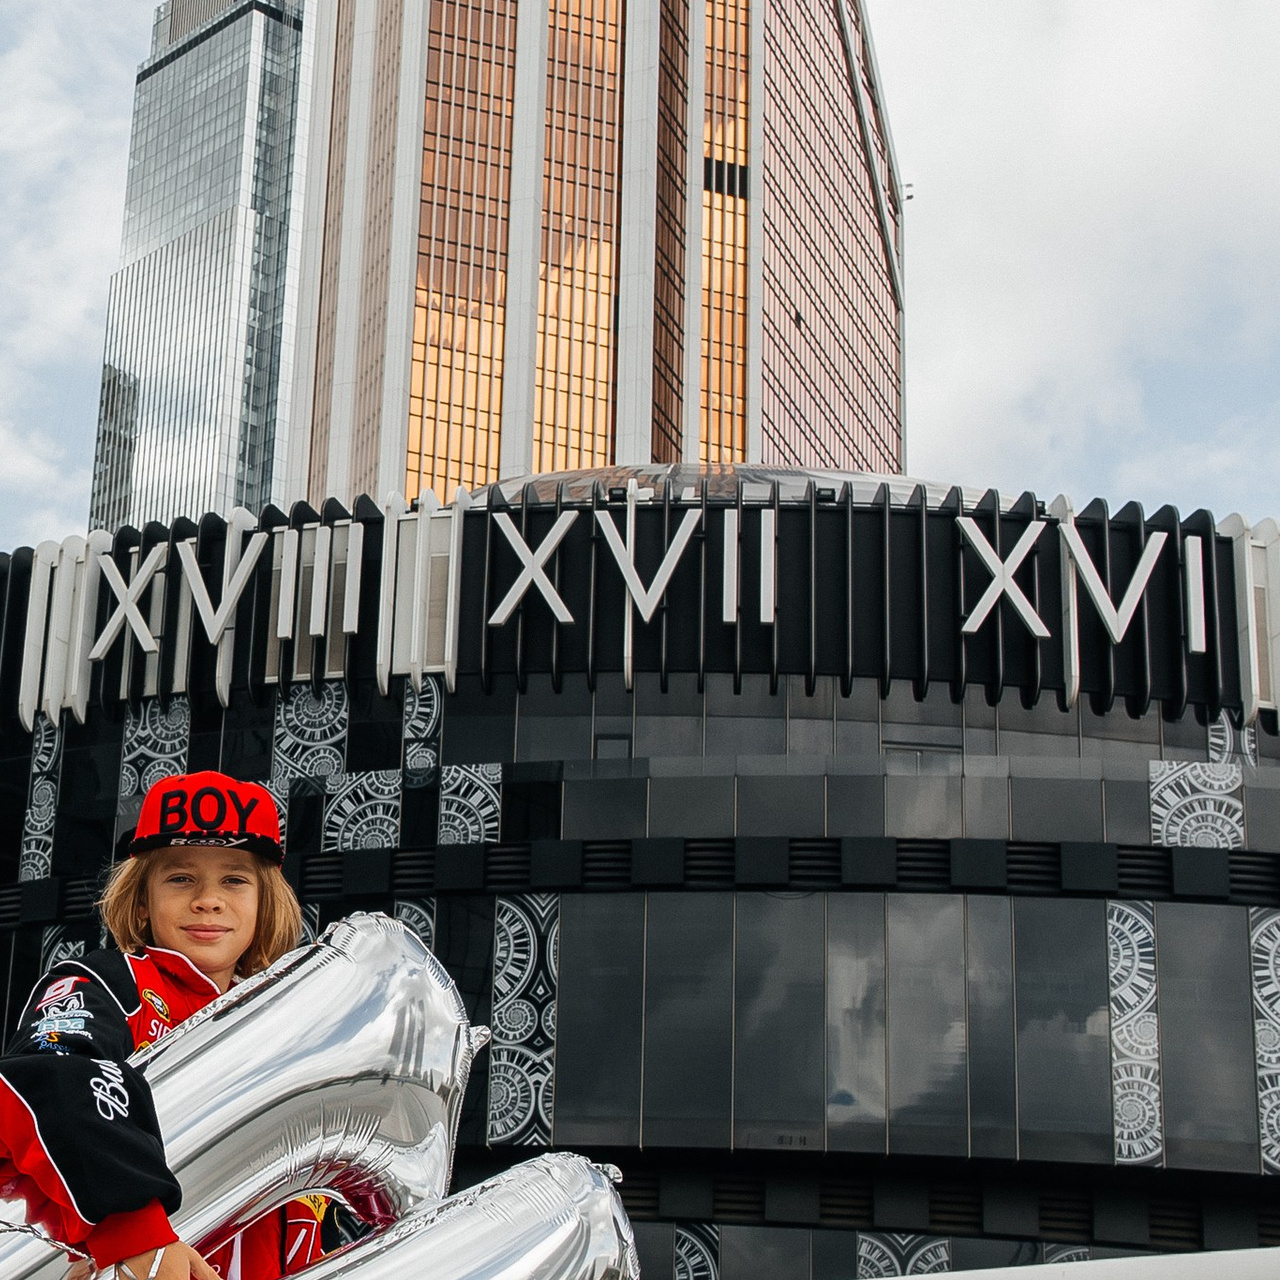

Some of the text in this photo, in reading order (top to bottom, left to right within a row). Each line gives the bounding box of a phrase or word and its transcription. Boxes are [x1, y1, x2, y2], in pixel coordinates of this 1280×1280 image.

[88, 522, 365, 662] XVIII
[489, 507, 776, 628] XVII
[956, 516, 1206, 654] XVI
[159, 786, 260, 833] BOY
